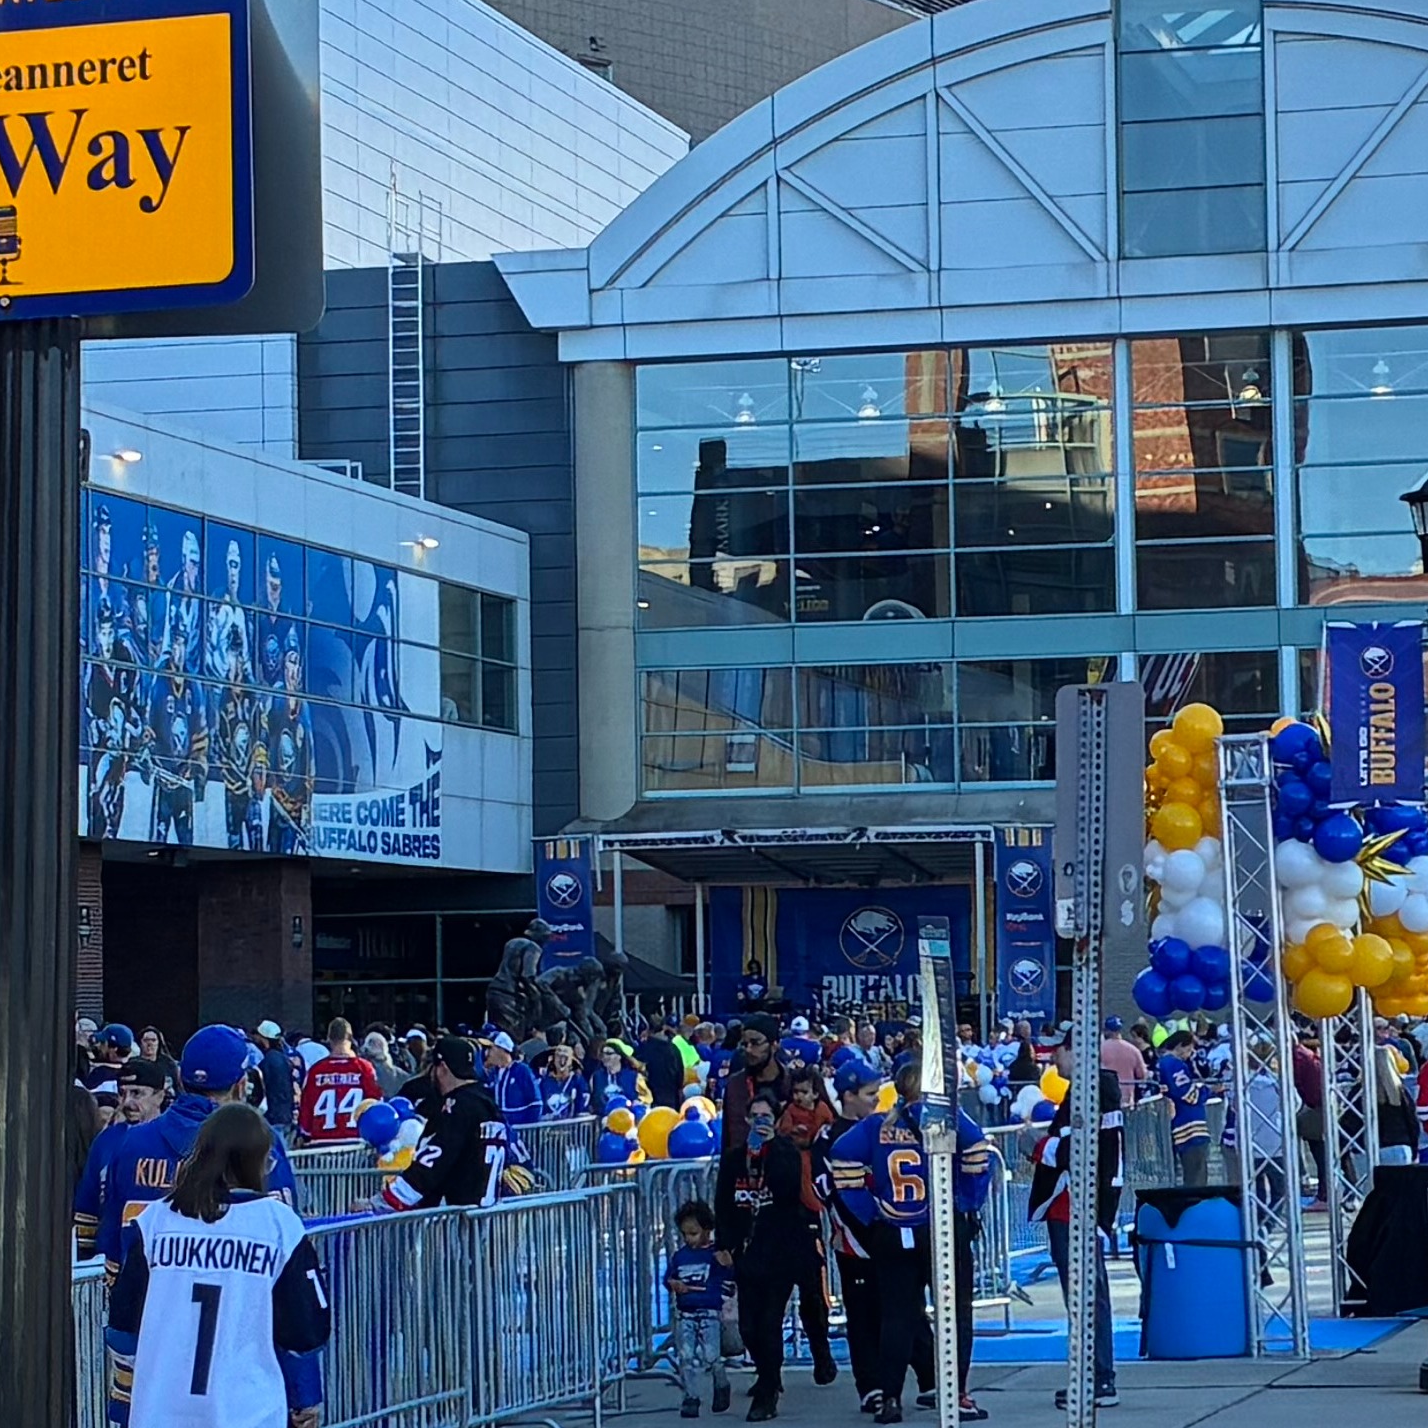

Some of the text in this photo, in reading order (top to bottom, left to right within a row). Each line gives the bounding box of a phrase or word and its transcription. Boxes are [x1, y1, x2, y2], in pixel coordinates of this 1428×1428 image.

[1369, 682, 1395, 784] BUFFALO
[356, 793, 406, 827] COME
[409, 770, 440, 828] THE
[381, 832, 440, 859] SABRES
[313, 1088, 363, 1130] 44
[888, 1149, 926, 1202] 6
[150, 1236, 279, 1277] LUUKKONEN
[190, 1282, 223, 1396] 1
